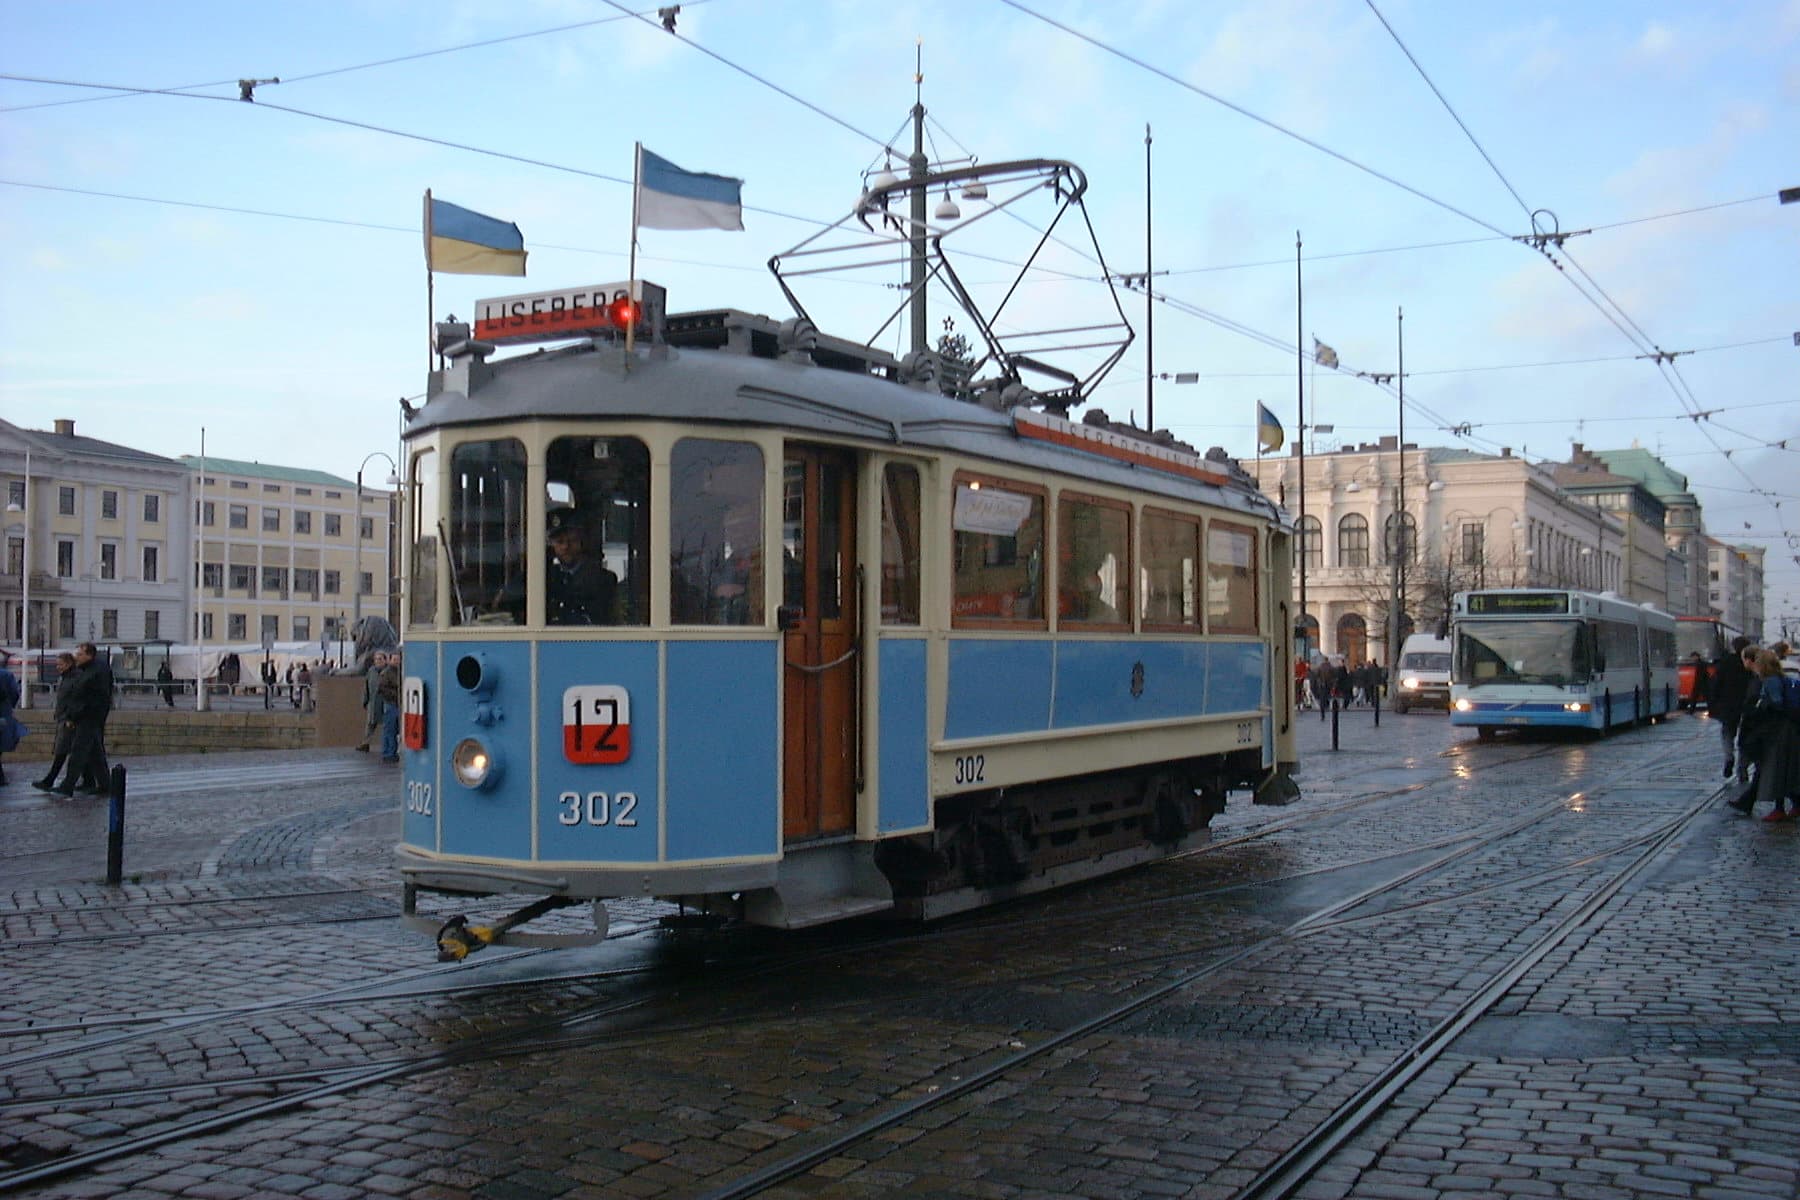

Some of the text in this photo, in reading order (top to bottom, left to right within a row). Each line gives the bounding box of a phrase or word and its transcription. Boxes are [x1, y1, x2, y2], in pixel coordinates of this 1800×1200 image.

[572, 698, 619, 752] 12
[955, 754, 986, 785] 302
[408, 780, 432, 816] 302
[559, 791, 638, 827] 302
